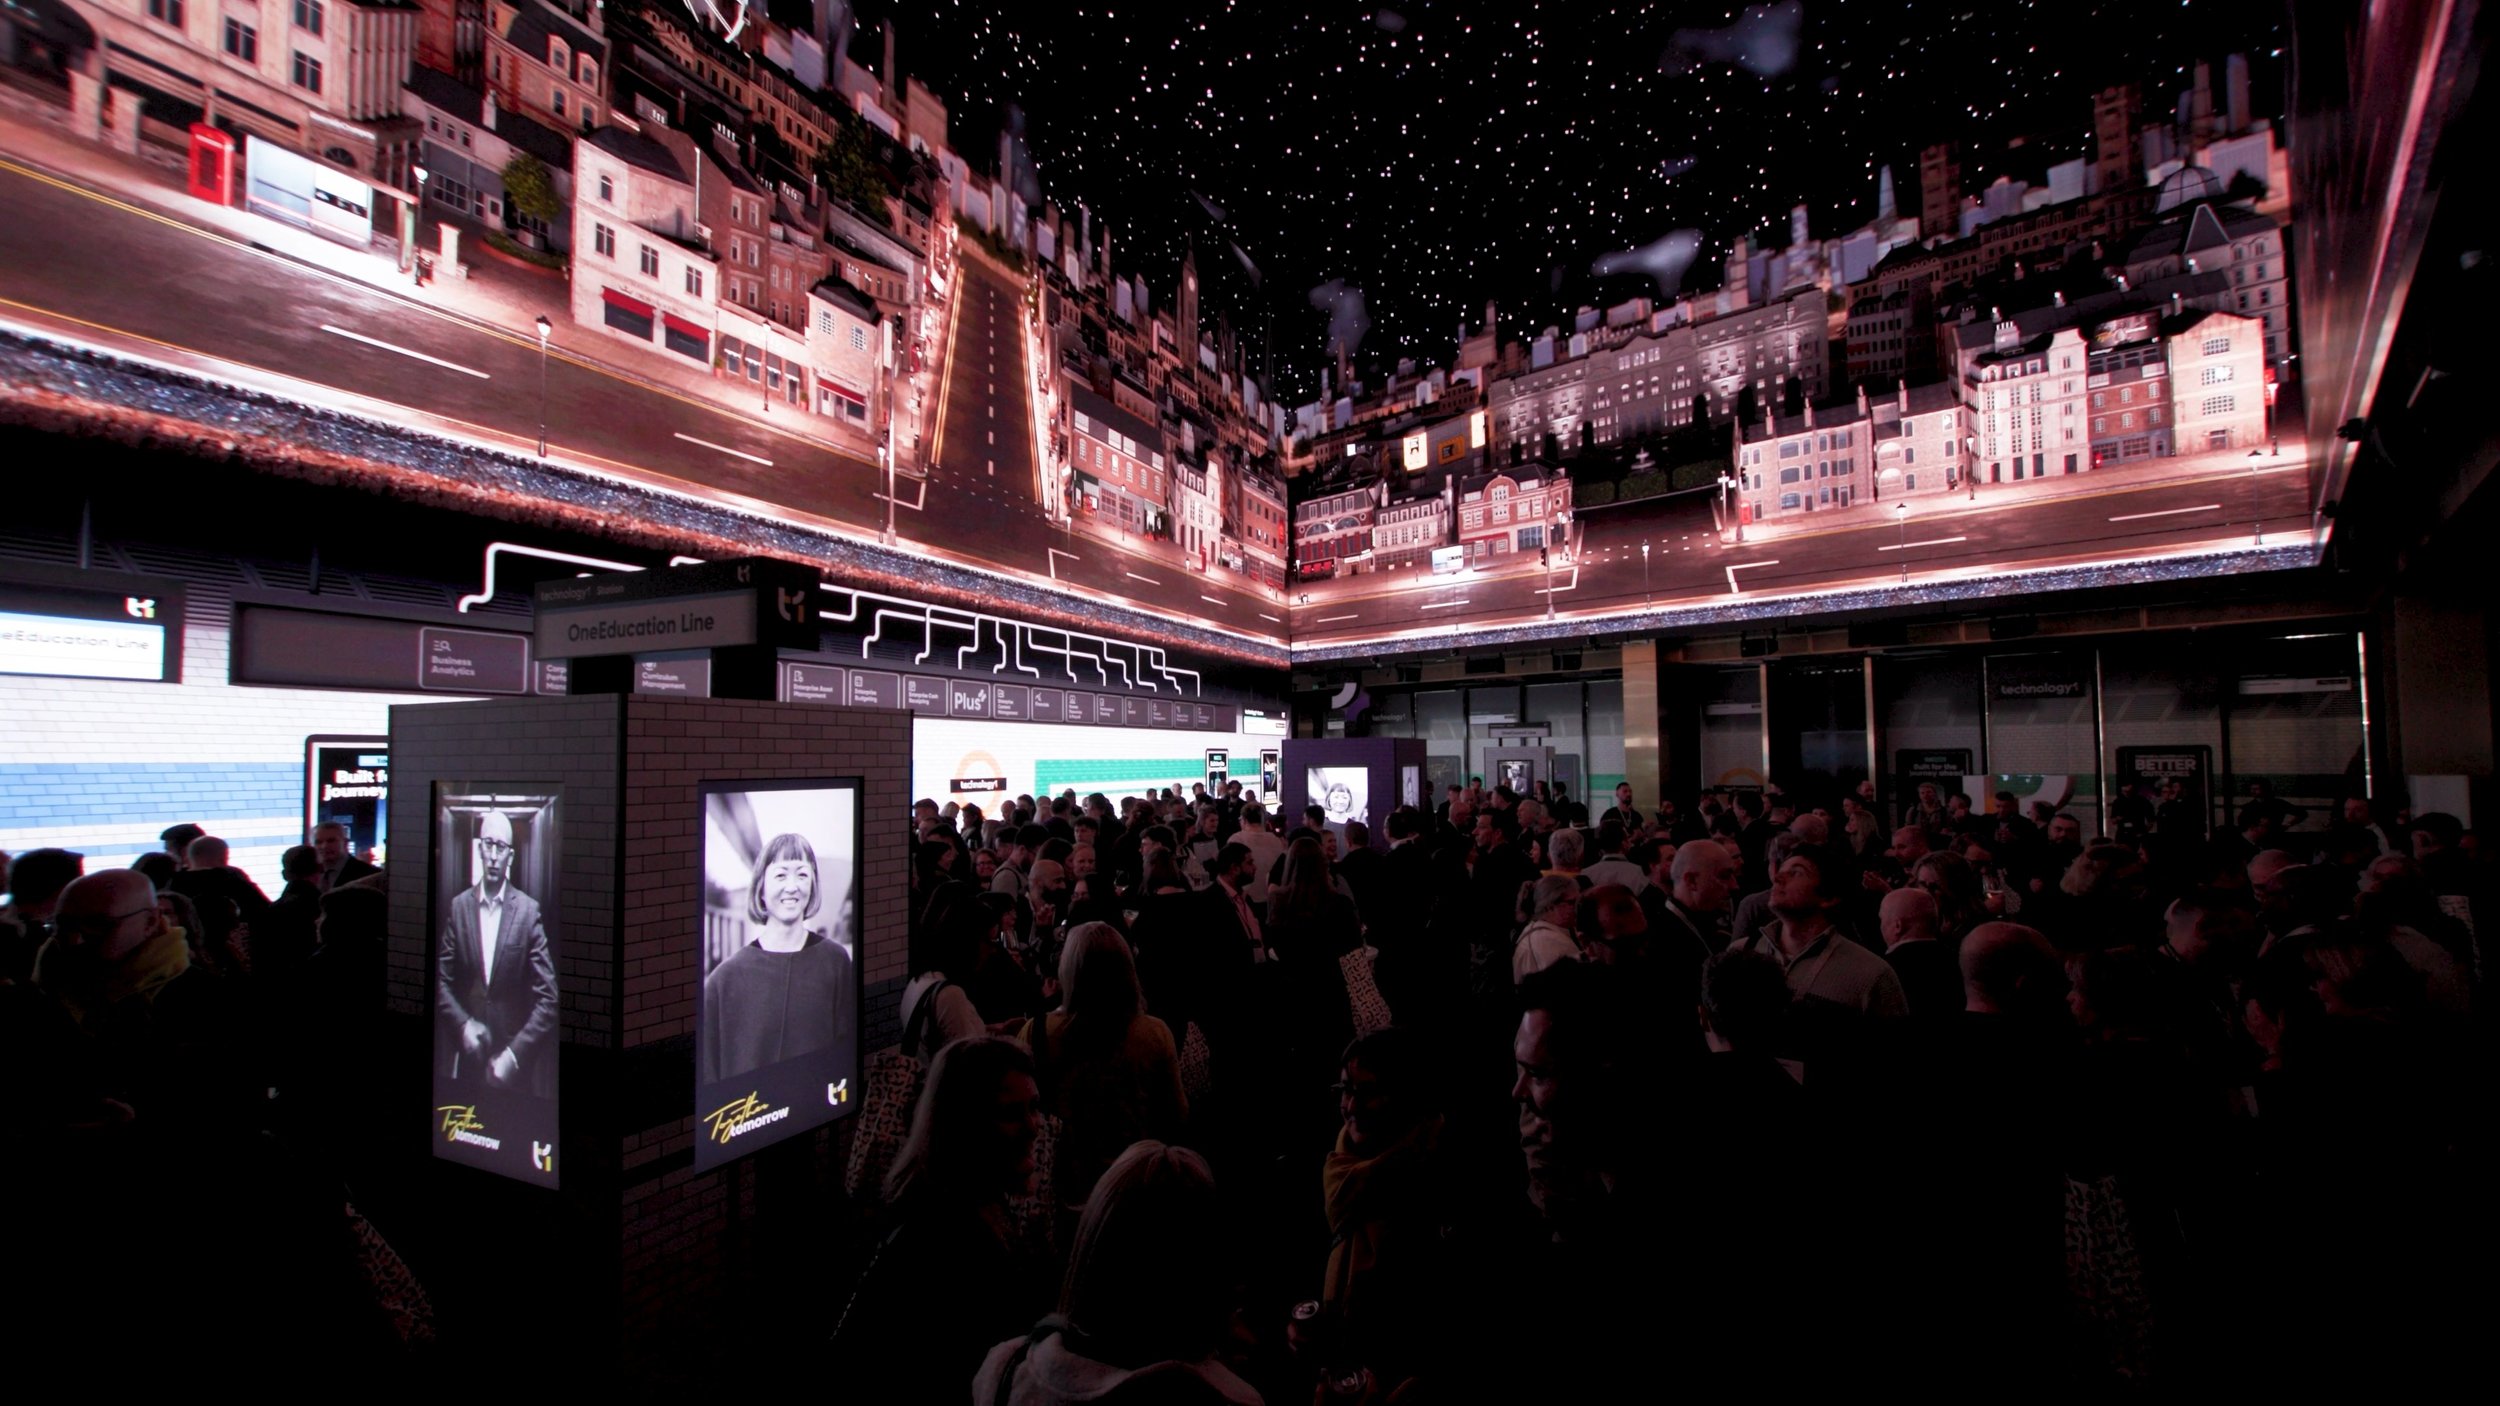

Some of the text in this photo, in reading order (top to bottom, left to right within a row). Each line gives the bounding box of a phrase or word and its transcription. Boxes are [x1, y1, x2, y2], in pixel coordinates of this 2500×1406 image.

[568, 612, 714, 642] OneEducation Line
[115, 636, 149, 650] Line
[431, 655, 472, 667] Business
[430, 665, 476, 677] Analytics
[2134, 758, 2197, 771] BETTER
[334, 769, 375, 784] Built
[322, 784, 388, 801] journey
[703, 1091, 769, 1144] Together
[730, 1106, 789, 1137] tomorrow
[455, 1129, 501, 1150] tomorrow
